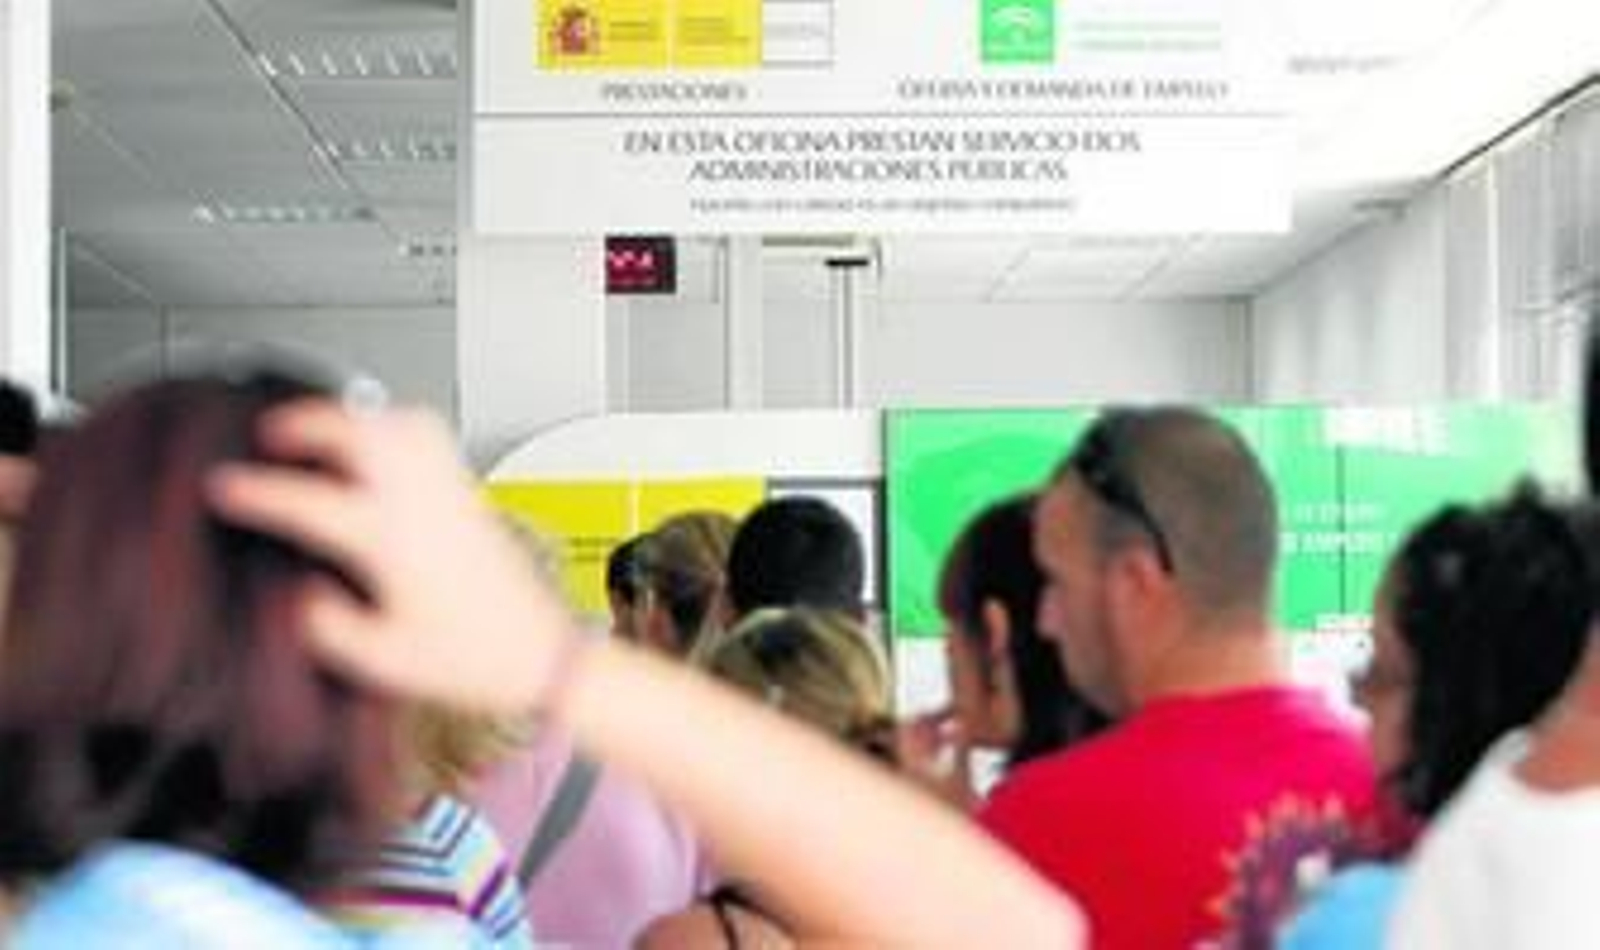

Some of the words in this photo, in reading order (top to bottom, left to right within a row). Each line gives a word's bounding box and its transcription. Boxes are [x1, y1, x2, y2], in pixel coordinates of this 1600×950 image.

[624, 131, 662, 151] EN
[668, 131, 729, 151] ESTA
[733, 131, 840, 151] OFICINA
[848, 131, 954, 151] PRESTAN
[961, 131, 1078, 151] SERVICIO
[1082, 131, 1141, 151] DOS
[690, 160, 942, 180] ADMINISTRACIONES
